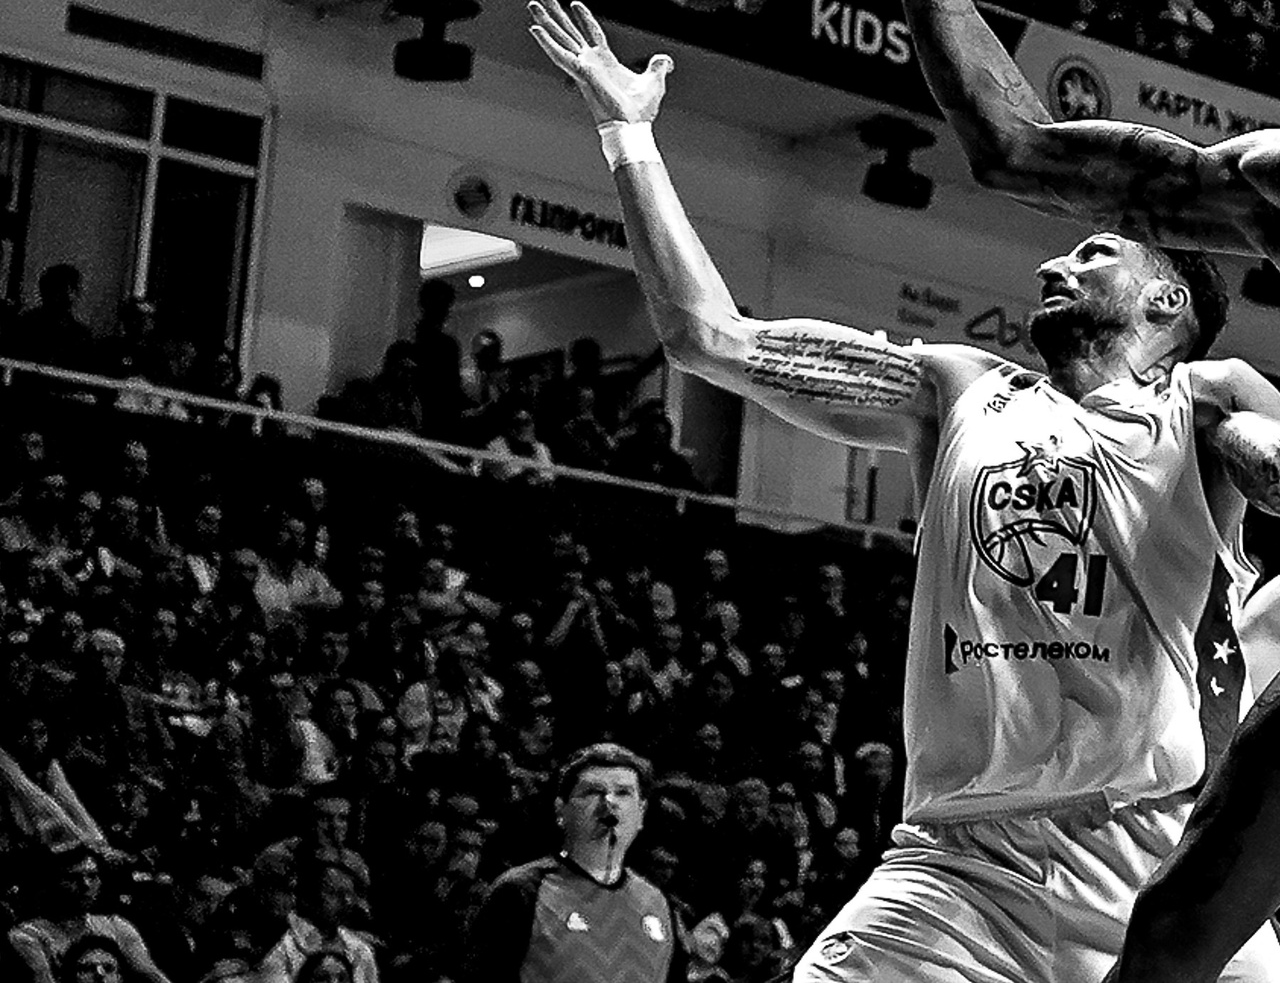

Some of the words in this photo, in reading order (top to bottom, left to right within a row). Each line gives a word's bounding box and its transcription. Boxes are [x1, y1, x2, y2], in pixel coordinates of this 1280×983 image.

[1137, 81, 1222, 131] КАРТА
[988, 477, 1079, 513] CSKA
[1034, 551, 1108, 617] 41
